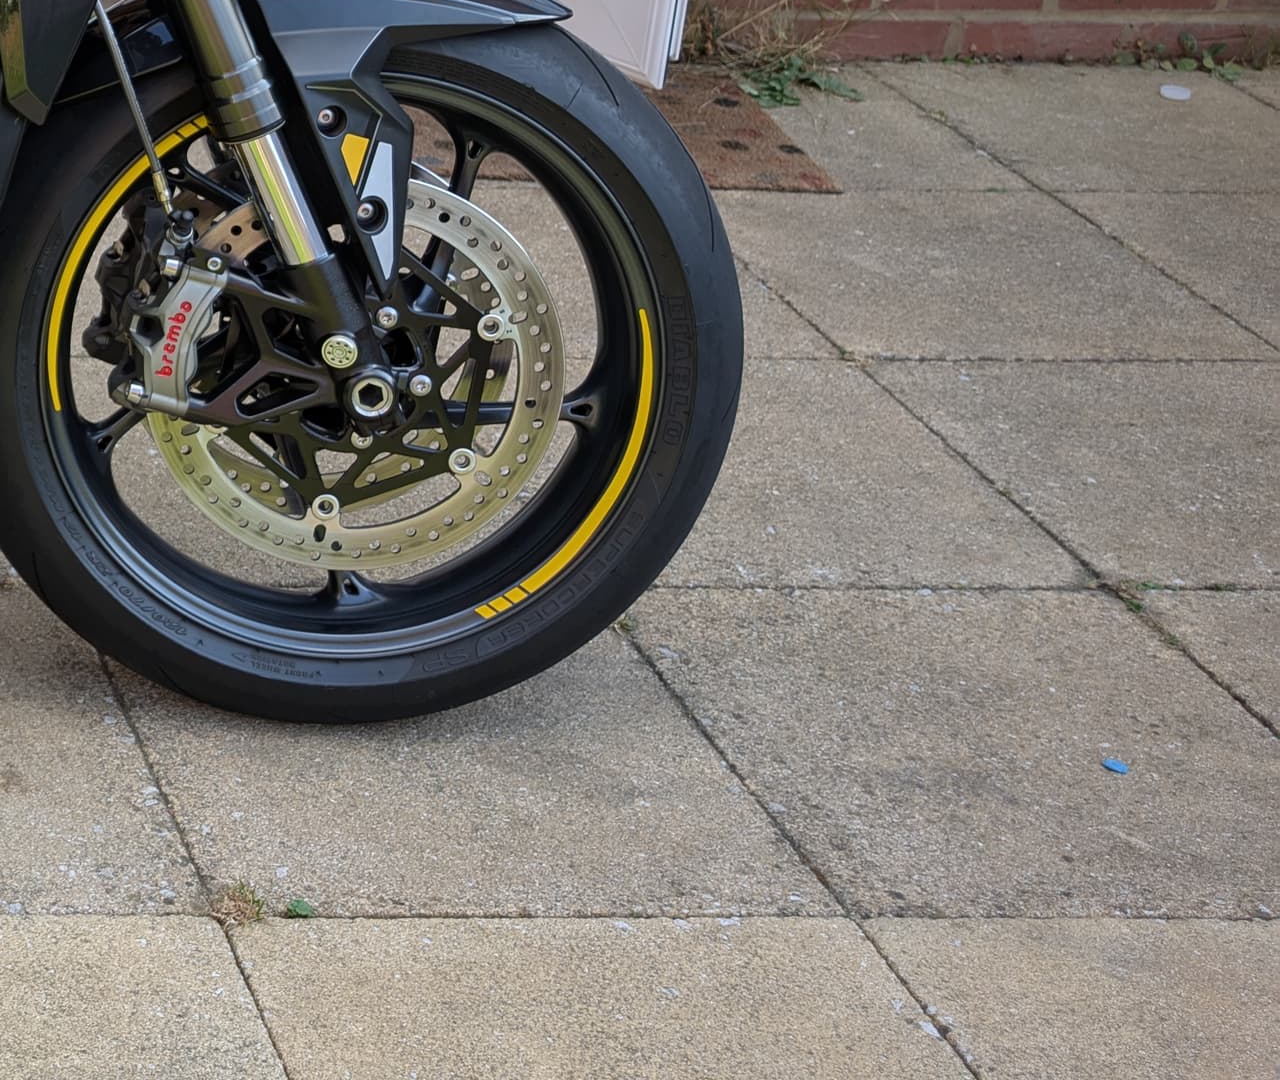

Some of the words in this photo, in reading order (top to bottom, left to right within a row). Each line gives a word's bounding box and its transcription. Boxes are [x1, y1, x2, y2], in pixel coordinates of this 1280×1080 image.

[154, 300, 194, 378] brembo
[662, 296, 693, 446] DIABLO
[489, 510, 645, 648] SUPERCORSA
[422, 647, 467, 673] SP
